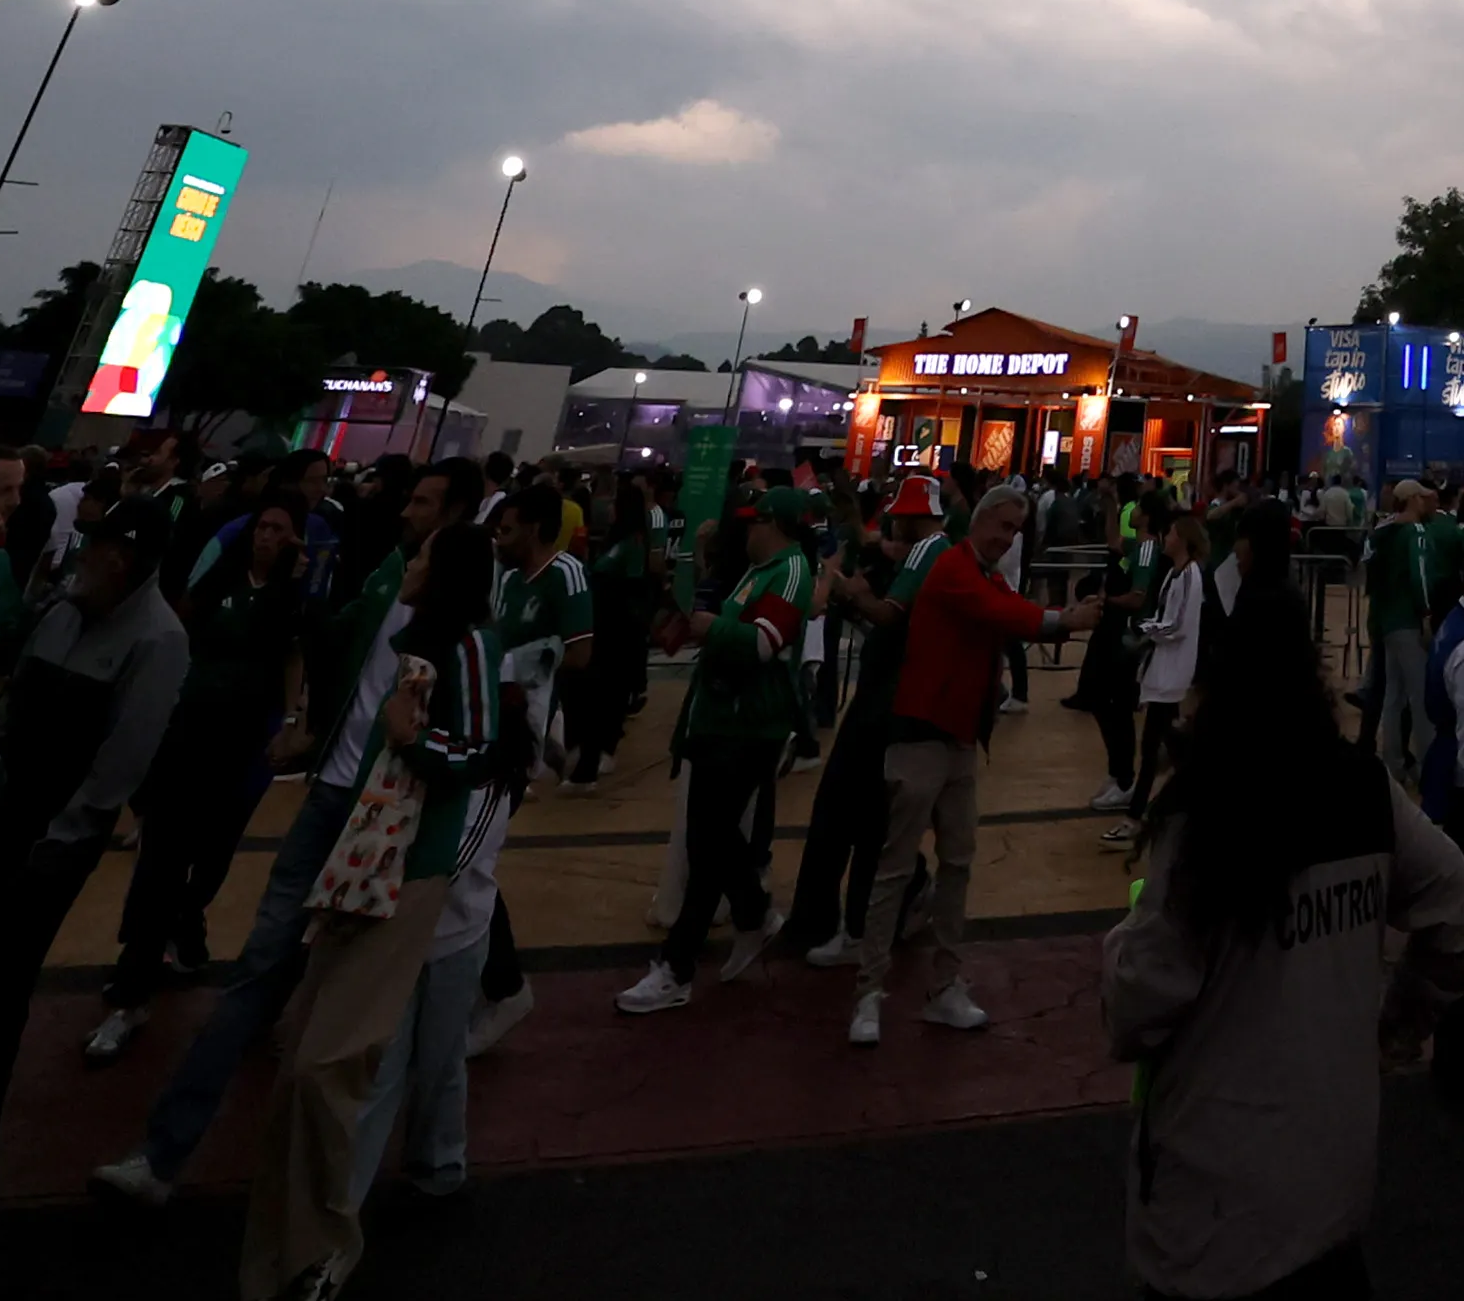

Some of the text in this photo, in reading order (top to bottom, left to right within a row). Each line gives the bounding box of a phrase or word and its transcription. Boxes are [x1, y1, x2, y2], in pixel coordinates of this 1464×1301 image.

[1331, 330, 1360, 347] VISA
[915, 353, 1068, 375] THE HOME DEPOT
[1325, 349, 1366, 369] tap in
